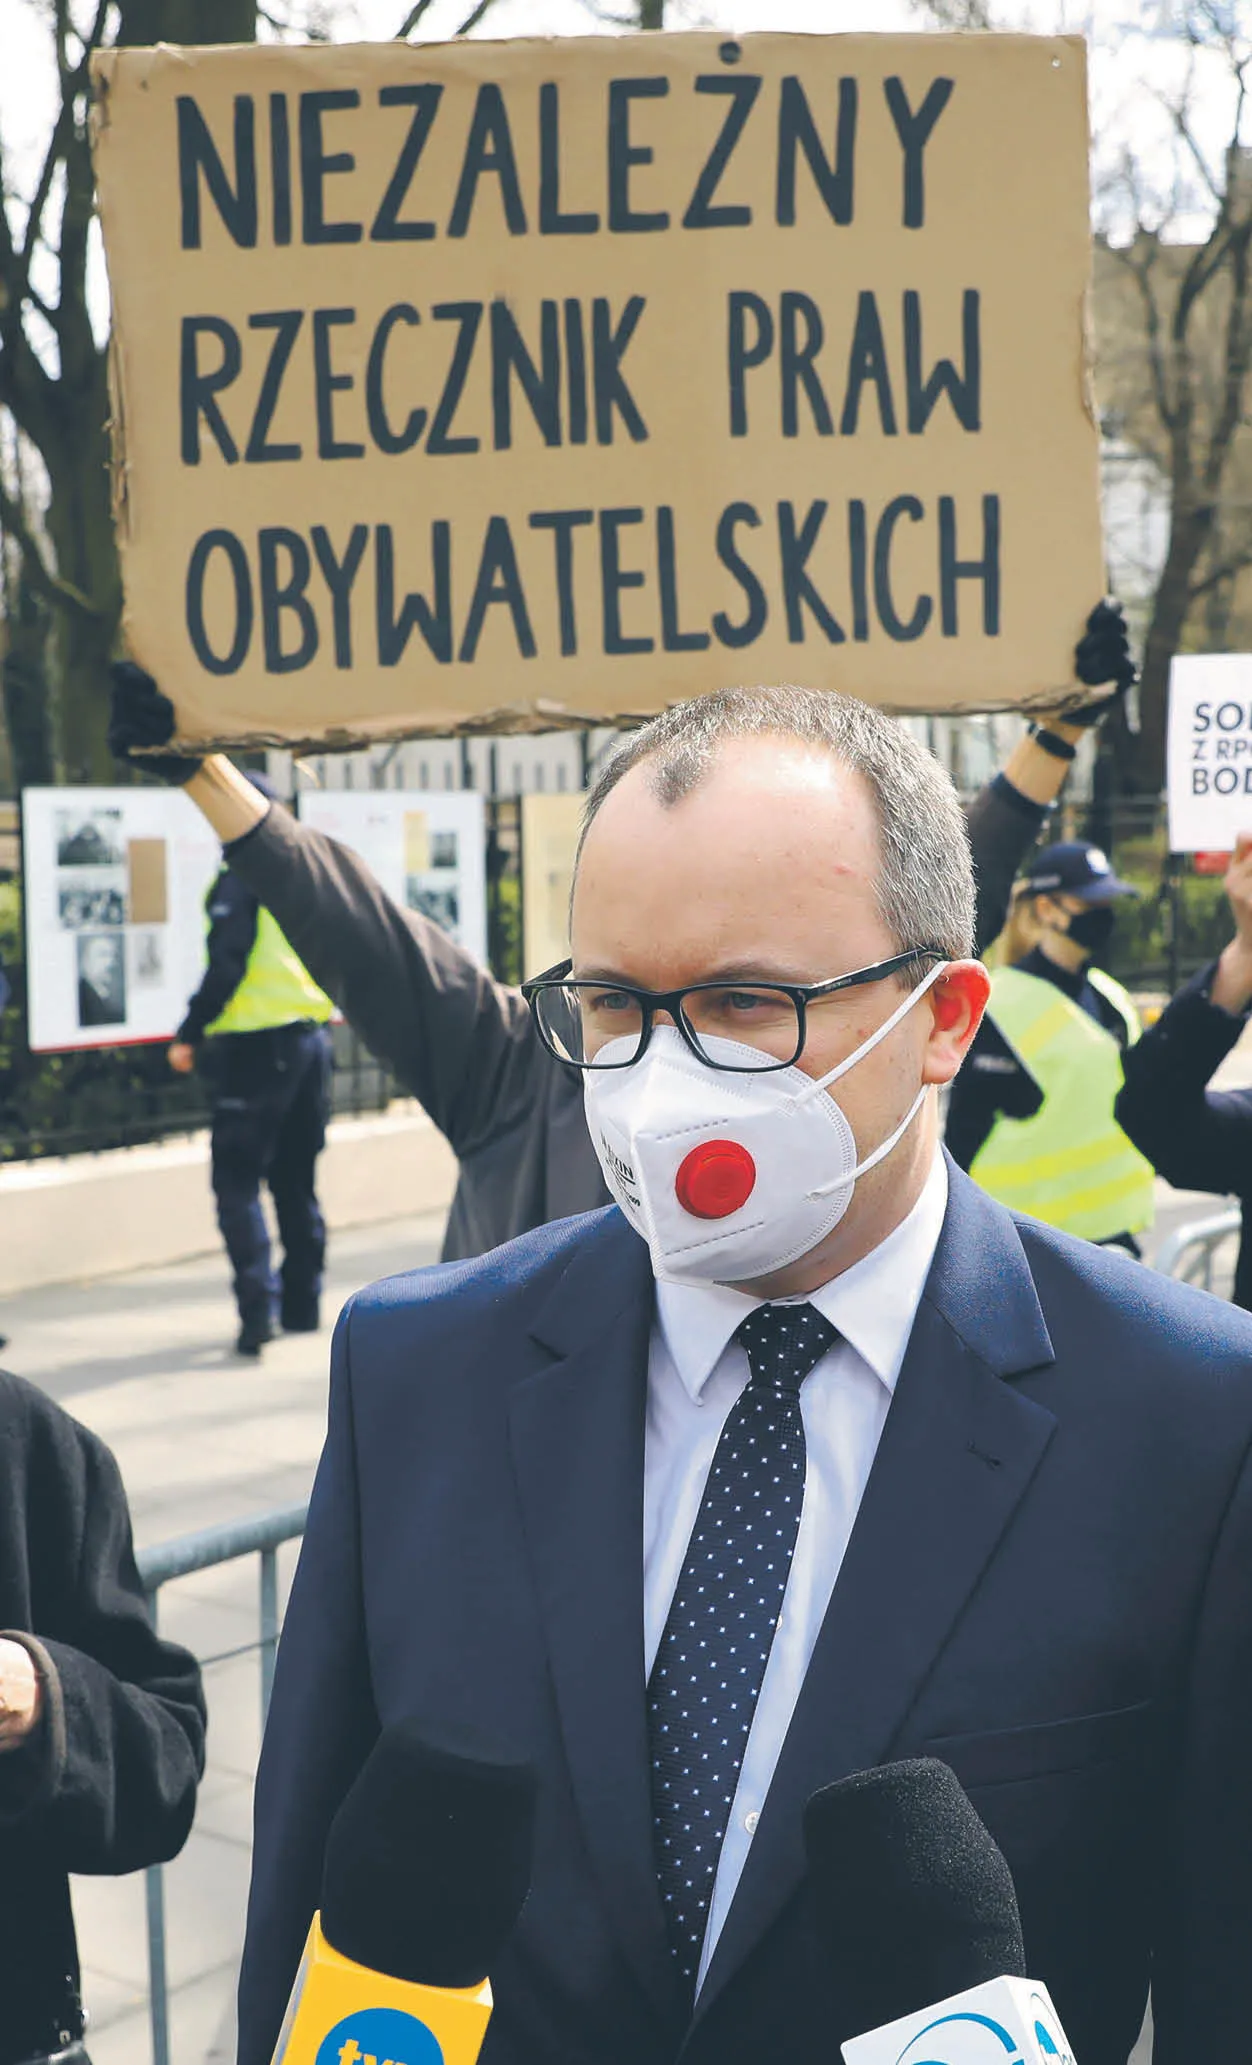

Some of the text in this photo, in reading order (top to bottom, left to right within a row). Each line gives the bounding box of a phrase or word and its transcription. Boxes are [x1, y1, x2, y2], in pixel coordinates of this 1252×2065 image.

[176, 42, 954, 249] NIEZALEŻNY
[180, 290, 980, 465] RZECZNIK PRAW
[186, 495, 999, 675] OBYWATELSKICH
[1192, 740, 1252, 760] Z RP
[1193, 702, 1252, 732] SO
